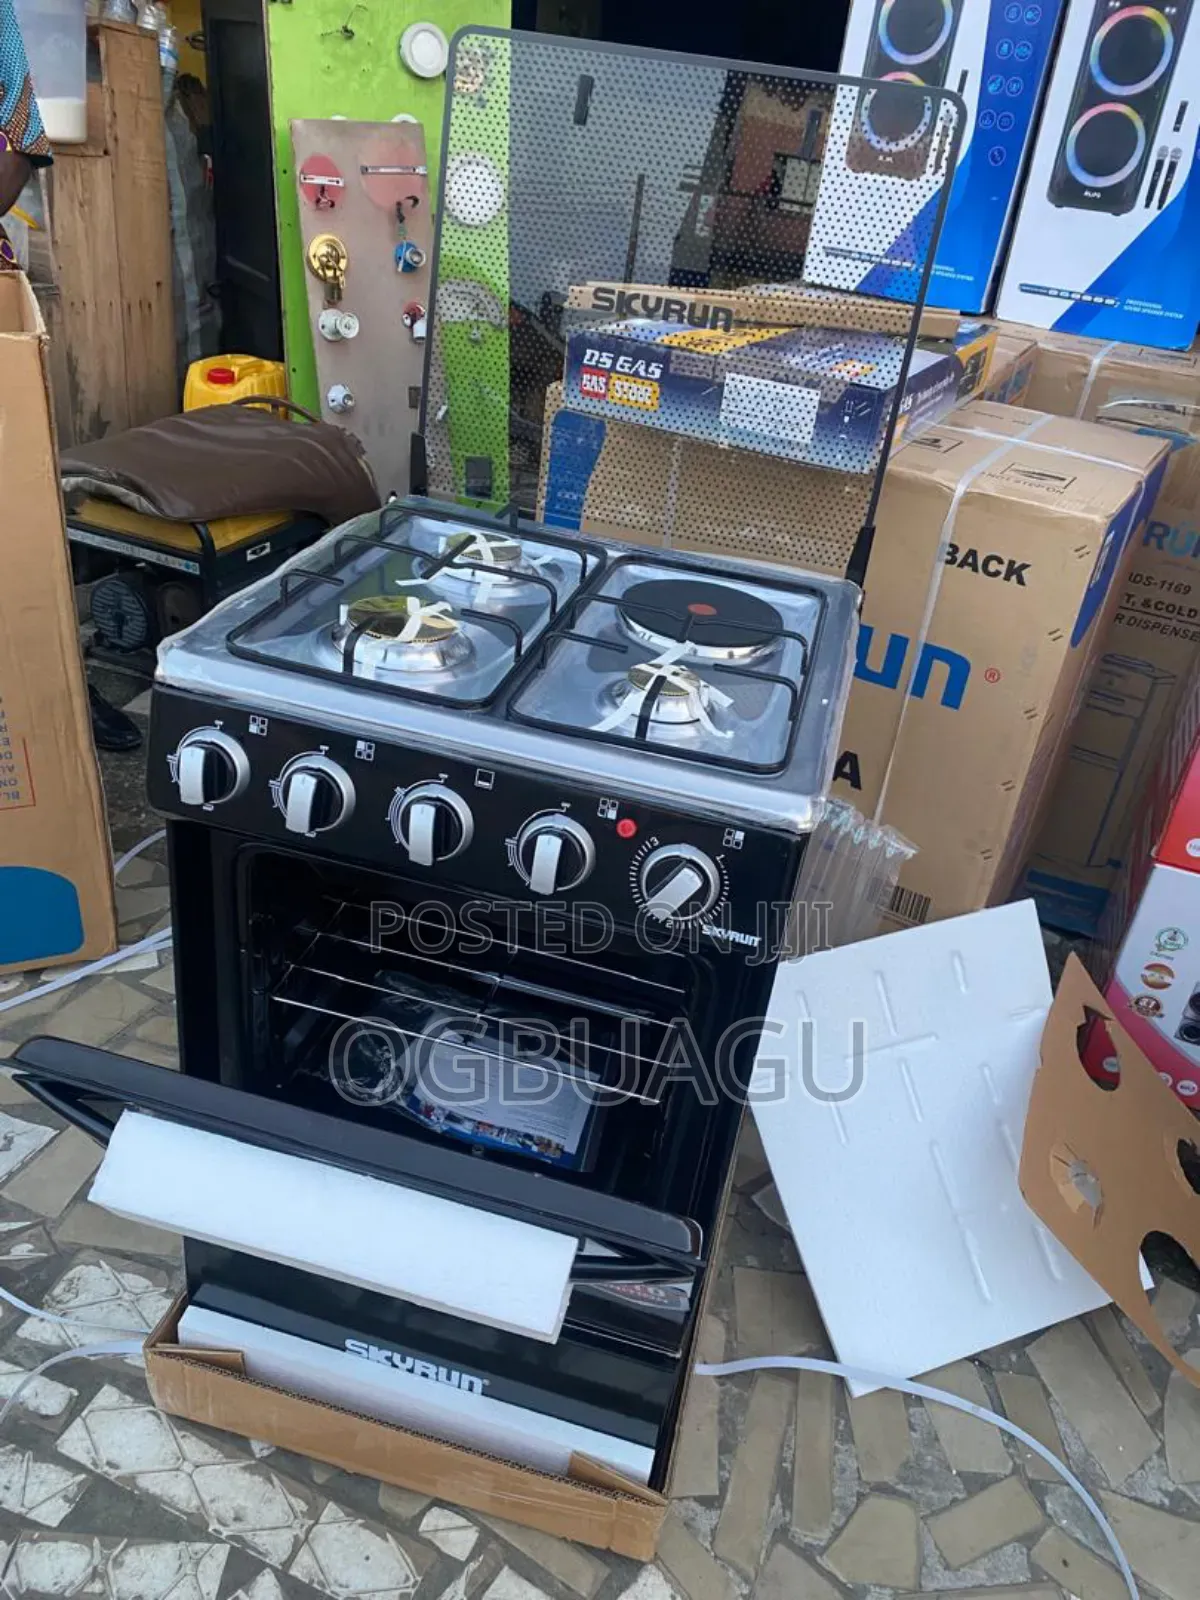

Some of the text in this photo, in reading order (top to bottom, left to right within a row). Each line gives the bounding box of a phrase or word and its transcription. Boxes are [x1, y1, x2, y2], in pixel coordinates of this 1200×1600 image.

[591, 286, 734, 333] SKYRUN
[581, 372, 607, 396] GAS
[583, 348, 664, 380] DS GAS
[945, 543, 1031, 586] BACK
[344, 1338, 484, 1395] SKYRUN
